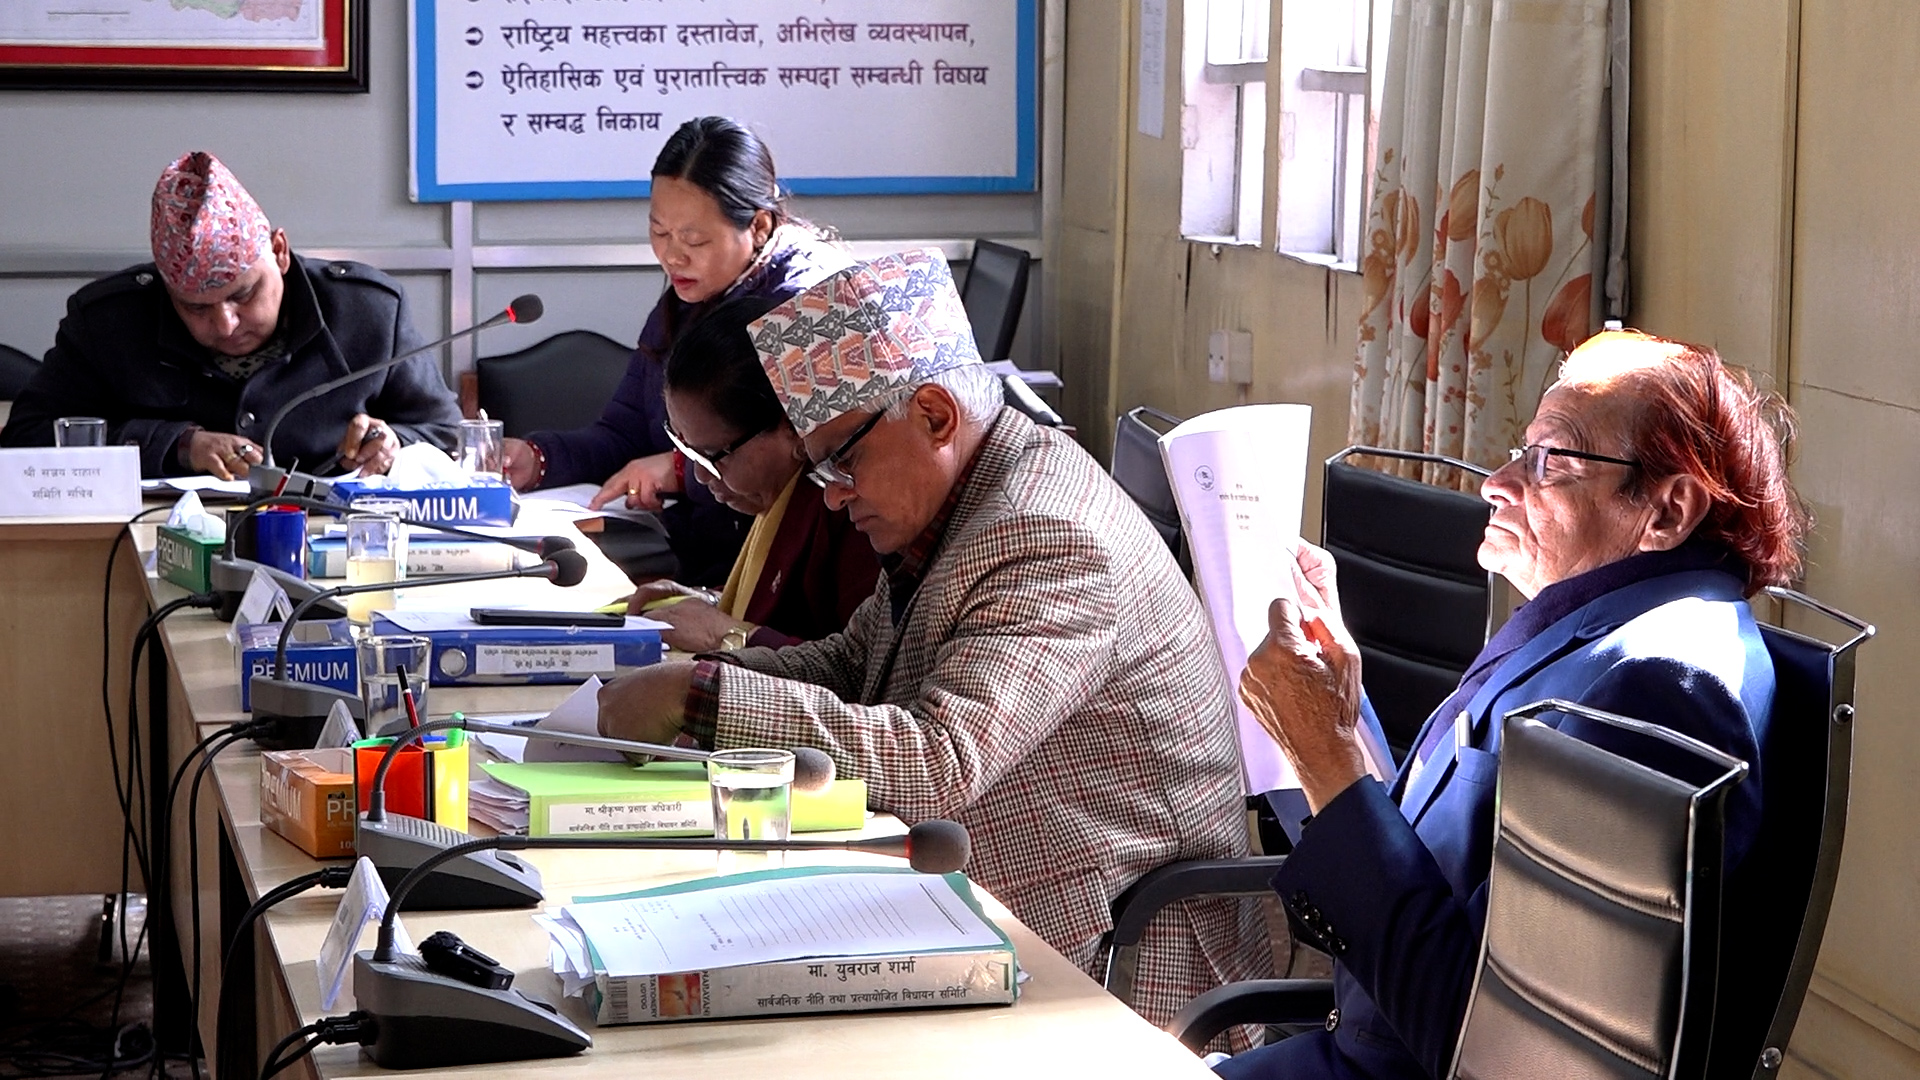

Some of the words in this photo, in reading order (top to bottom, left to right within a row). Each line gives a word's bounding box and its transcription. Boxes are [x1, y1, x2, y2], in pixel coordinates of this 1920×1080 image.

[500, 19, 572, 52] राष्ट्रिय
[582, 25, 667, 48] महत्त्वका
[677, 19, 764, 47] दस्तावेज,
[777, 16, 858, 45] अभिलेख
[867, 23, 975, 47] व्यवस्थापन,
[501, 62, 603, 94] ऐतिहासिक
[613, 64, 645, 92] एवं
[654, 61, 768, 95] पुरातात्त्विक
[778, 67, 841, 89] सम्पदा
[850, 60, 924, 88] सम्बन्धी
[933, 59, 989, 85] विषय
[501, 113, 517, 136] र
[527, 113, 586, 135] सम्बद्ध
[596, 106, 662, 133] निकाय
[411, 496, 478, 521] MIUM
[651, 801, 682, 812] अधिकारी
[807, 965, 827, 978] मा.
[836, 961, 881, 982] युवराज
[887, 956, 916, 975] शर्मा
[757, 993, 801, 1008] सार्वजनिक
[805, 991, 825, 1005] नीति
[829, 994, 846, 1005] तथा
[850, 989, 898, 1005] प्रत्यायोजित
[902, 987, 935, 1000] विधायन
[938, 985, 967, 999] समिति
